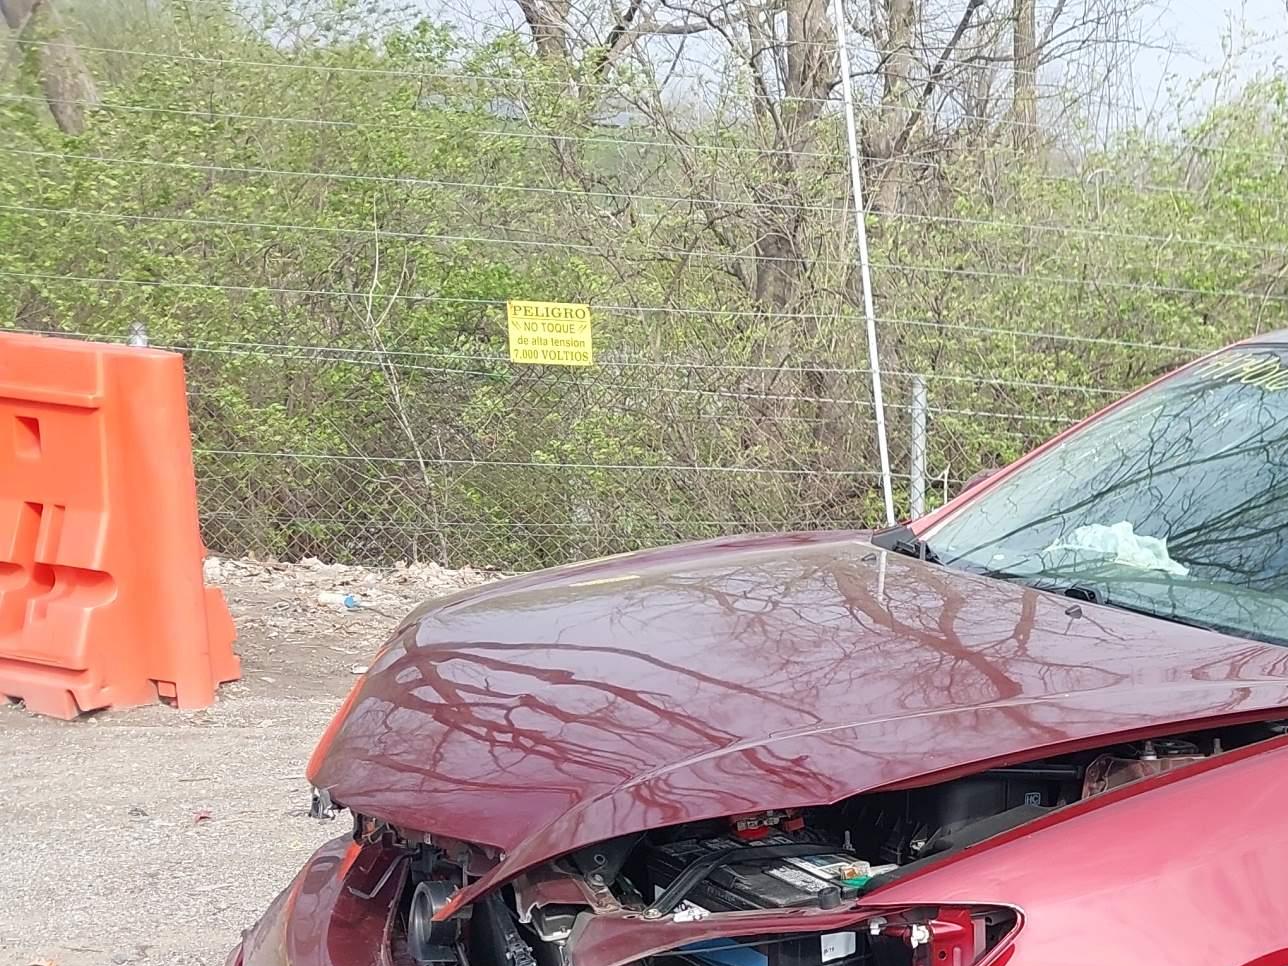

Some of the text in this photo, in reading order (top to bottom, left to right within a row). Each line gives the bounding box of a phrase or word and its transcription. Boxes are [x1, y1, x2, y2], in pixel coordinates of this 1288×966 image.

[512, 305, 586, 319] PELIGRO
[524, 322, 576, 334] NO TOQUE
[518, 336, 529, 345] de
[531, 336, 548, 346] alta
[514, 349, 589, 361] 7.000 VOLTIOS
